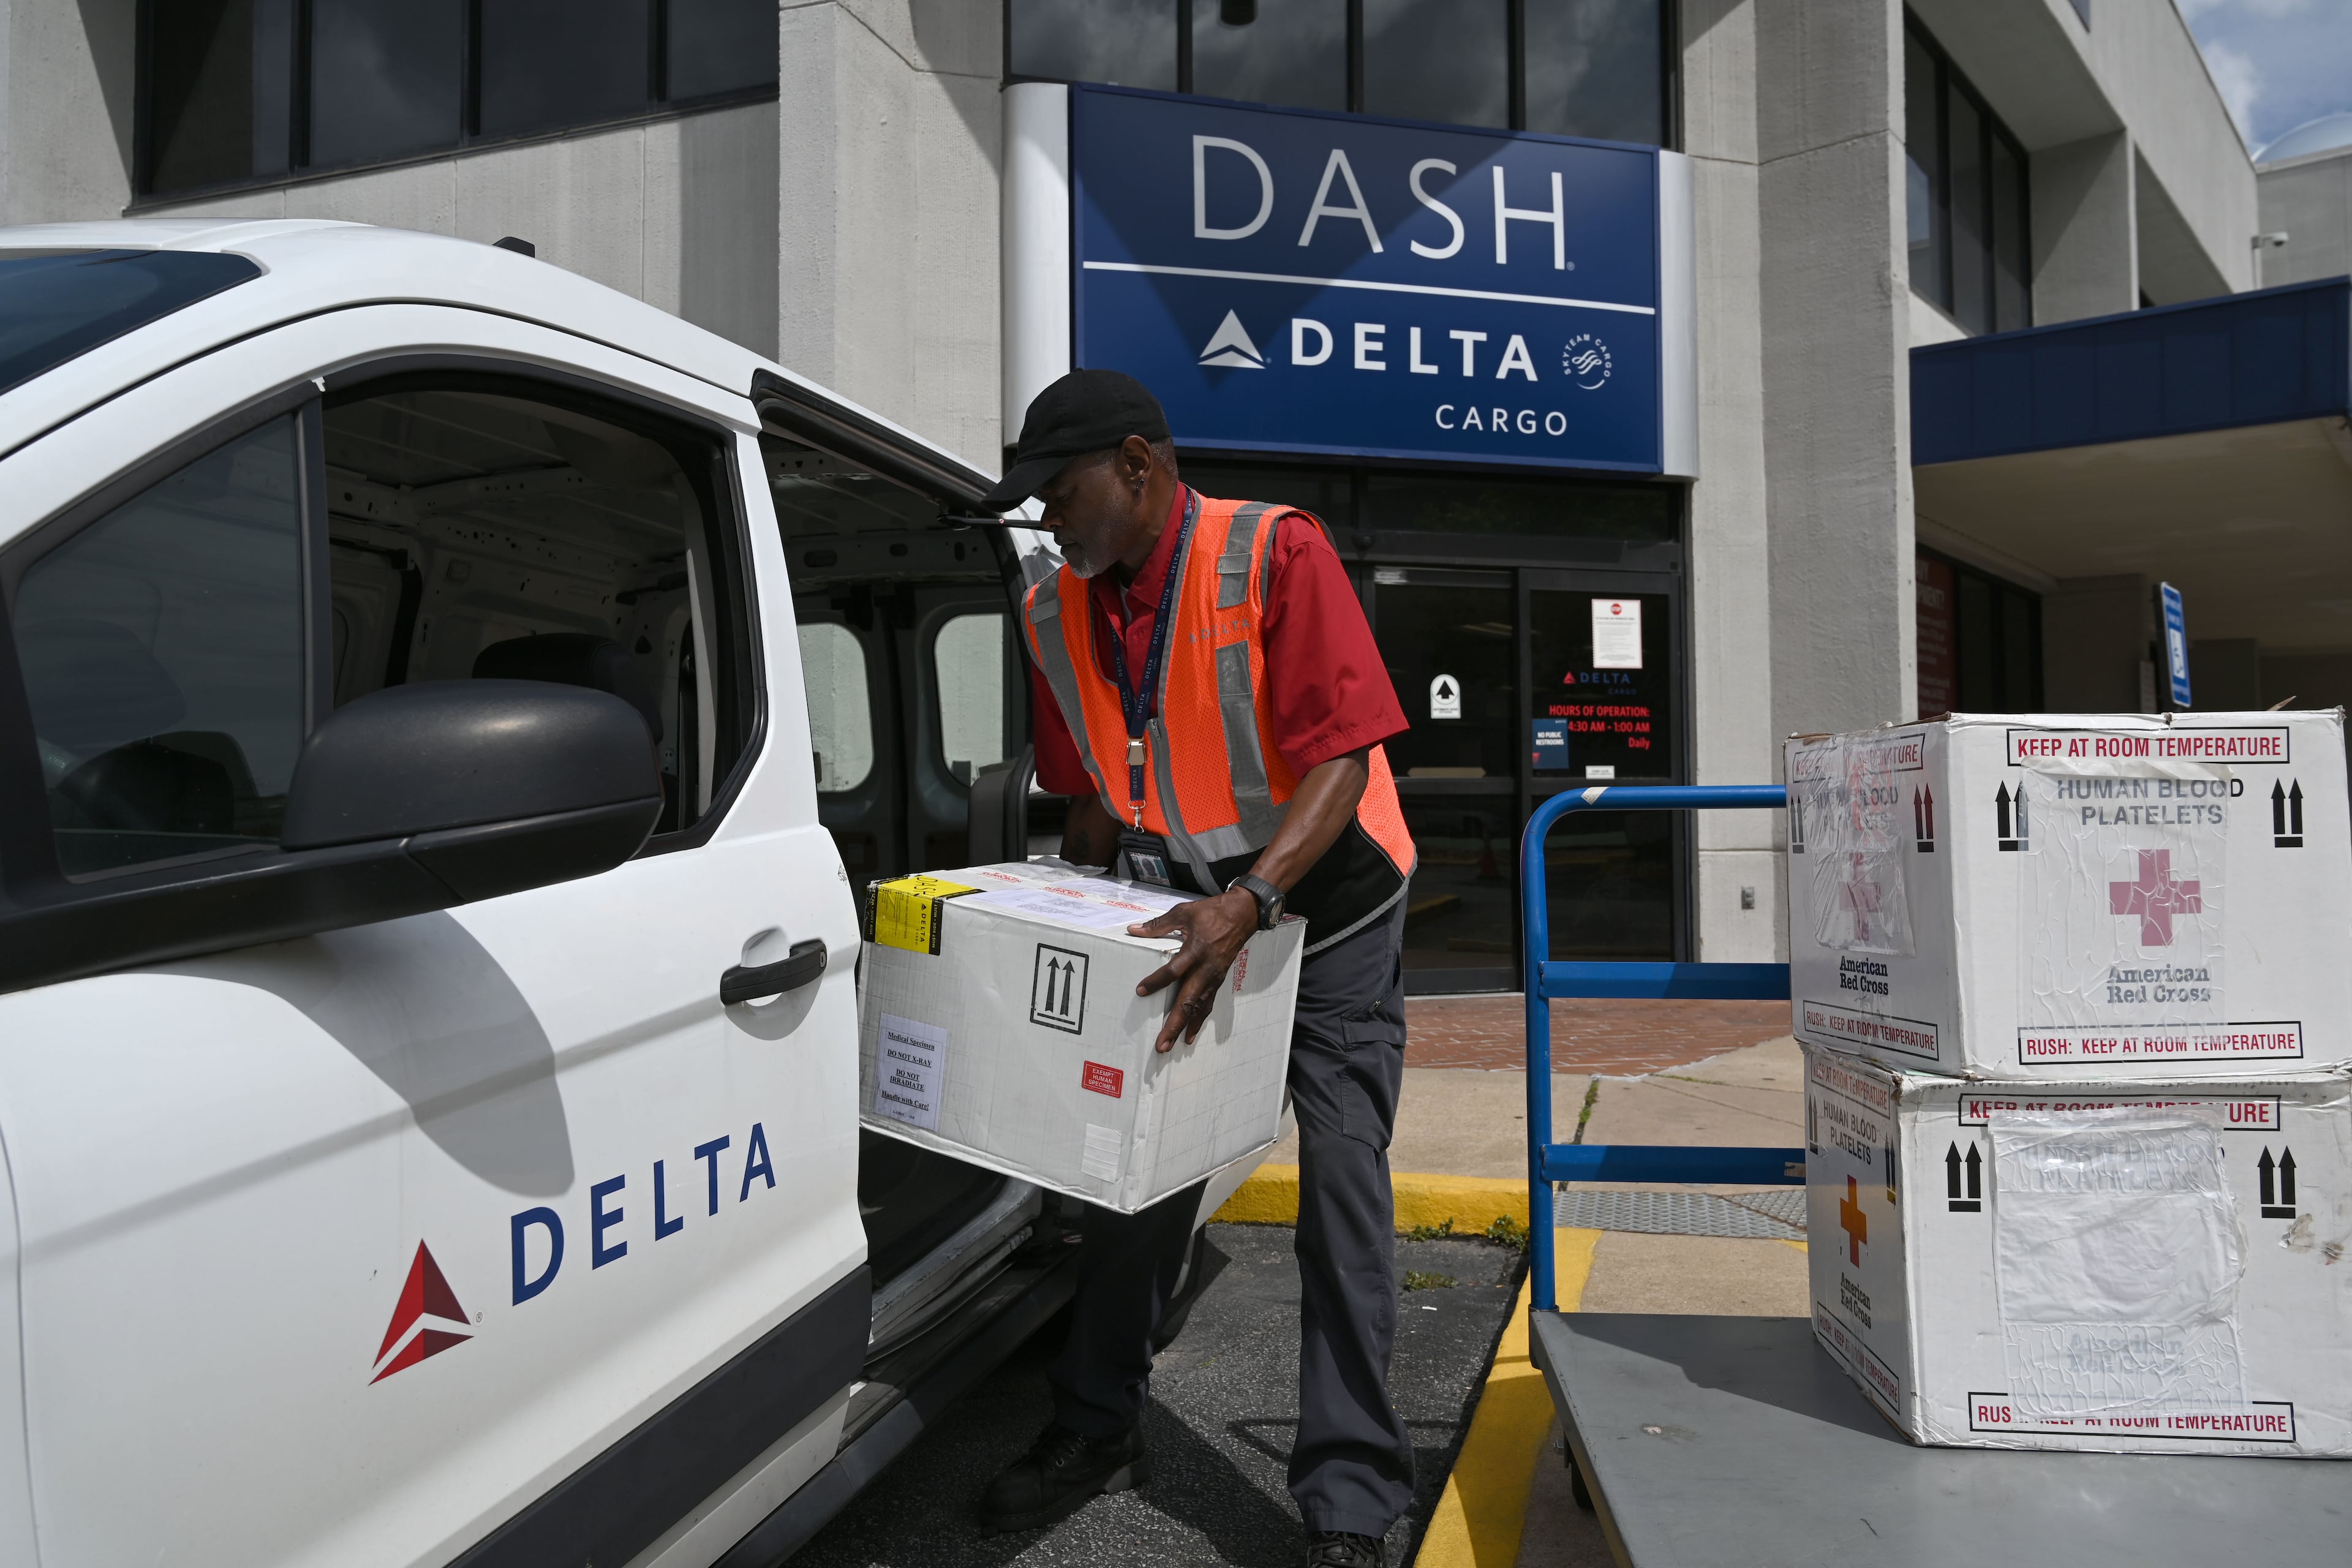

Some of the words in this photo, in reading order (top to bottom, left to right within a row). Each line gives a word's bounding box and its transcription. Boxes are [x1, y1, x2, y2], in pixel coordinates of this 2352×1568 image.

[1193, 135, 1566, 271] DASH
[1291, 318, 1539, 382] DELTA
[1562, 334, 1591, 375] SKYTEAM
[1594, 339, 1612, 377] CARGO
[1435, 404, 1567, 436] CARGO
[1180, 519, 1190, 539] DELTA
[1170, 552, 1180, 574] DELTA
[1161, 589, 1170, 609] DELTA
[1153, 624, 1161, 644] DELTA
[1200, 618, 1251, 639] DELTA
[1145, 659, 1153, 679] DELTA
[1580, 672, 1630, 684] DELTA
[1137, 693, 1145, 714] DELTA
[1549, 705, 1580, 715] HOURS
[1583, 706, 1594, 715] OF
[1596, 706, 1650, 717] OPERATION:
[1568, 721, 1588, 731] 4:30
[1590, 722, 1605, 731] AM
[1614, 722, 1634, 732] 1:00
[1635, 722, 1650, 732] AM
[1629, 737, 1651, 750] Daily
[2018, 739, 2062, 757] KEEP
[2068, 738, 2089, 757] AT
[2096, 737, 2149, 757] ROOM
[2155, 737, 2282, 756] TEMPERATURE
[2057, 779, 2149, 799] HUMAN
[2158, 778, 2244, 797] BLOOD
[2082, 805, 2223, 825] PLATELETS
[1839, 956, 1888, 977] American
[2107, 963, 2210, 983] American
[1840, 973, 1858, 990] Red
[1860, 976, 1889, 995] Cross
[2107, 986, 2146, 1003] Red
[2153, 985, 2211, 1003] Cross
[888, 1031, 909, 1044] Medical
[910, 1038, 935, 1050] Specimen
[1807, 1011, 1826, 1027] RUSH:
[1830, 1015, 1845, 1031] KEEP
[1847, 1019, 1855, 1033] AT
[1857, 1021, 1879, 1038] ROOM
[1880, 1025, 1935, 1050] TEMPERATURE
[2027, 1039, 2072, 1055] RUSH:
[2082, 1038, 2117, 1054] KEEP
[2122, 1036, 2138, 1053] AT
[2193, 1033, 2296, 1051] TEMPERATURE
[898, 1052, 911, 1061] NOT
[912, 1055, 932, 1066] X-RAY
[1093, 1068, 1114, 1078] EXEMPT
[1093, 1074, 1112, 1084] HUMAN
[890, 1076, 924, 1091] IRRADIATE
[1088, 1079, 1115, 1091] SPECIMEN
[1826, 1066, 1832, 1084] AT
[1833, 1068, 1848, 1091] ROOM
[1849, 1076, 1887, 1110] TEMPERATURE
[882, 1090, 901, 1101] Handle
[902, 1096, 913, 1104] with
[914, 1100, 929, 1110] Care!
[1823, 1100, 1849, 1128] HUMAN
[1851, 1114, 1877, 1144] BLOOD
[1830, 1126, 1871, 1165] PLATELETS
[511, 1123, 776, 1307] DELTA
[1841, 1272, 1871, 1311] American
[1841, 1288, 1853, 1314] Red
[1853, 1300, 1872, 1330] Cross
[1819, 1314, 1833, 1338] RUSH:
[1834, 1327, 1845, 1348] KEEP
[1865, 1355, 1898, 1404] TEMPERATURE
